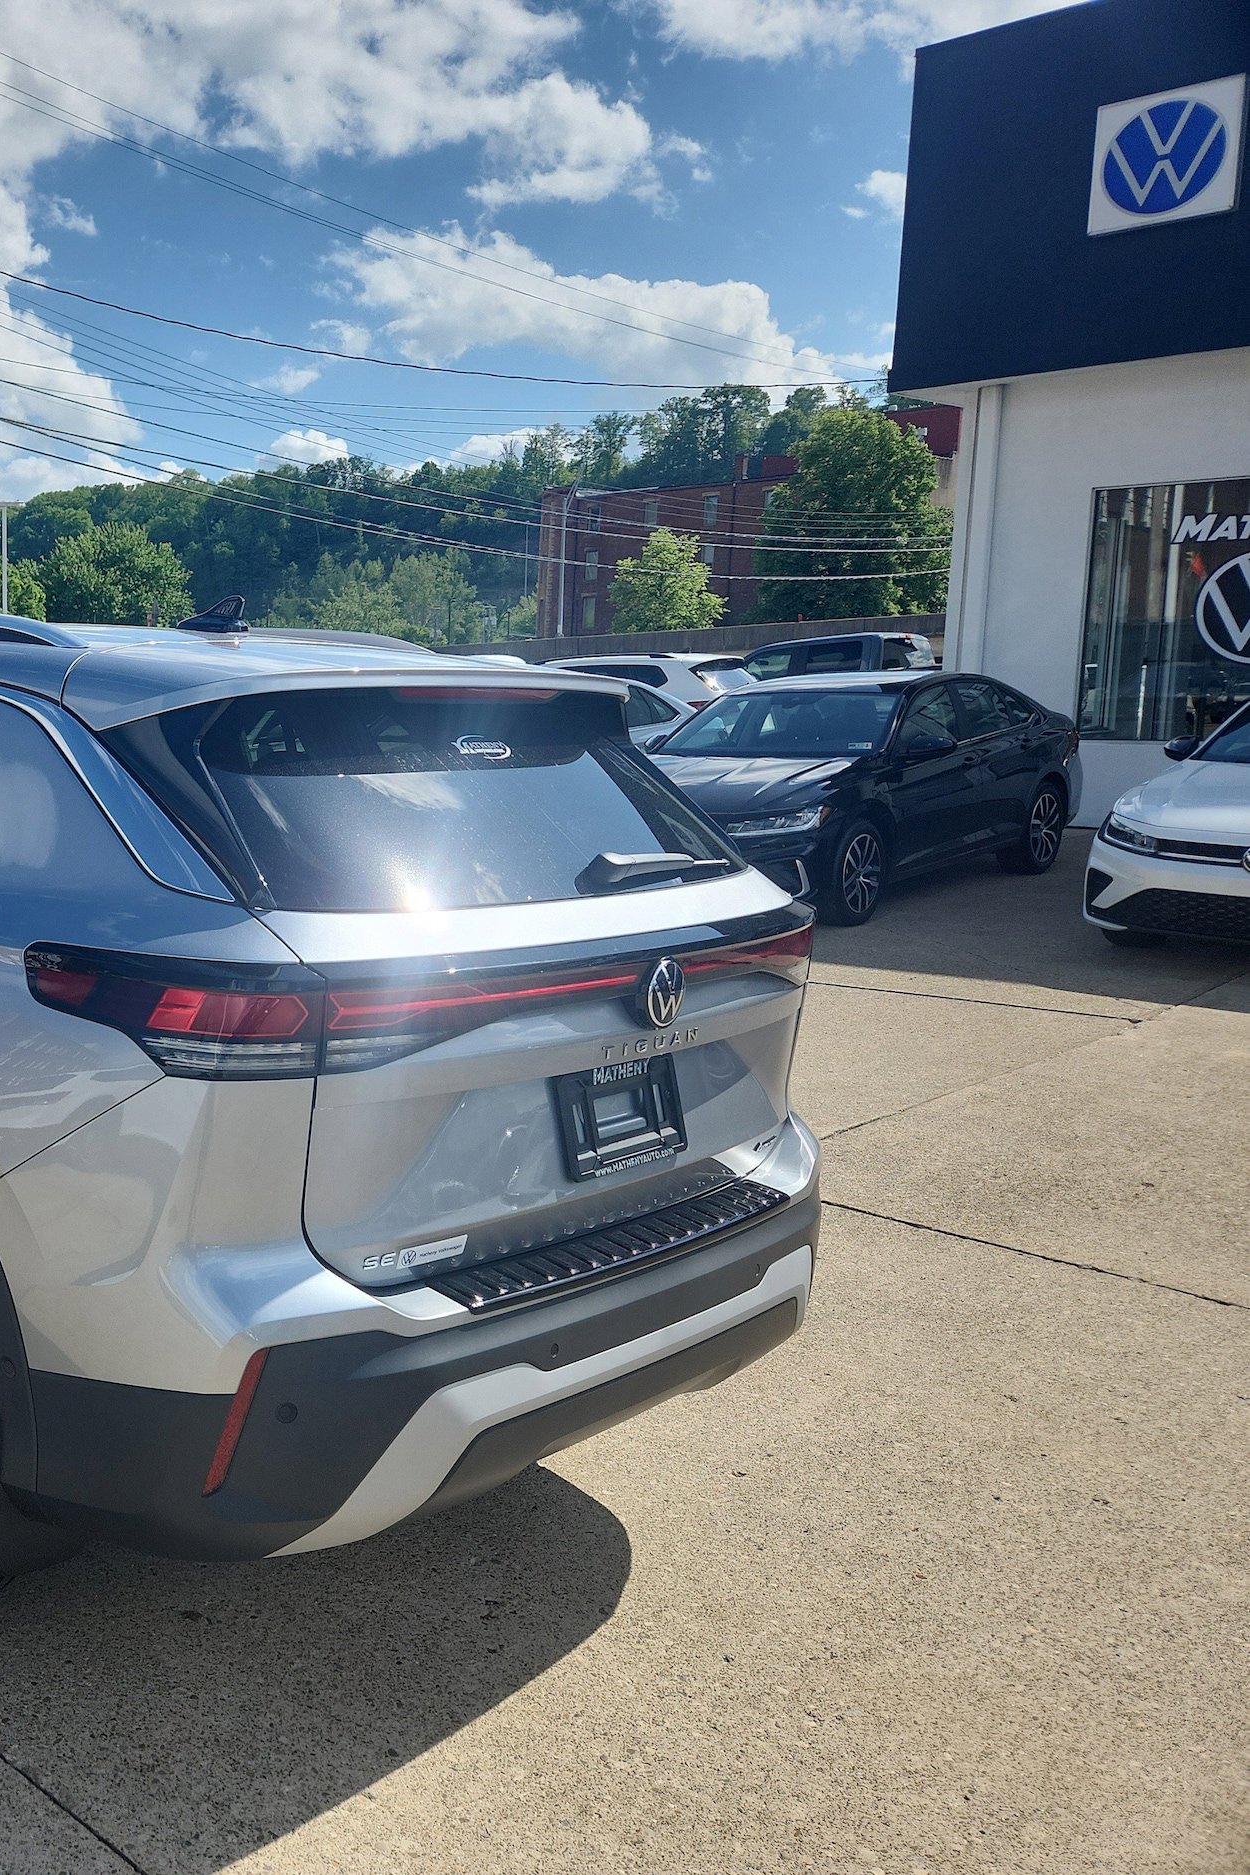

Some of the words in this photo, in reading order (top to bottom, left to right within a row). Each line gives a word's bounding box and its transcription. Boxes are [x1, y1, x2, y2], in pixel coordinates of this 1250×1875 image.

[601, 1027, 699, 1060] TIGUAN
[593, 1058, 651, 1087] MATHENY
[363, 1252, 397, 1271] SE
